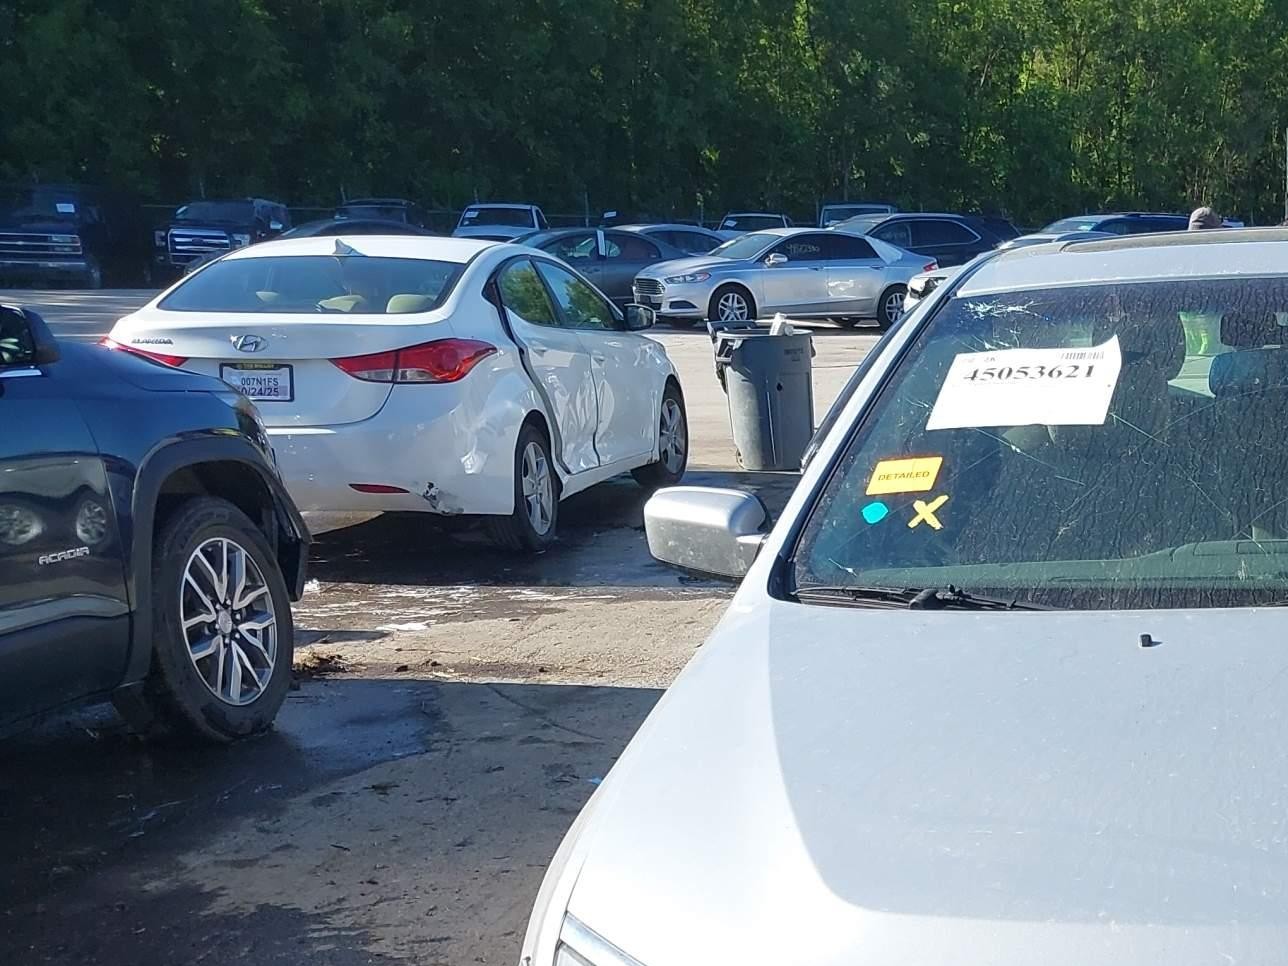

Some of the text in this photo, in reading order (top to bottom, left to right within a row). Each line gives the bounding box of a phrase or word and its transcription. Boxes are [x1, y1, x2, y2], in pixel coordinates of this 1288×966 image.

[964, 365, 1095, 381] 45053621
[877, 471, 930, 481] DETAILED
[38, 546, 90, 565] ACADIA
